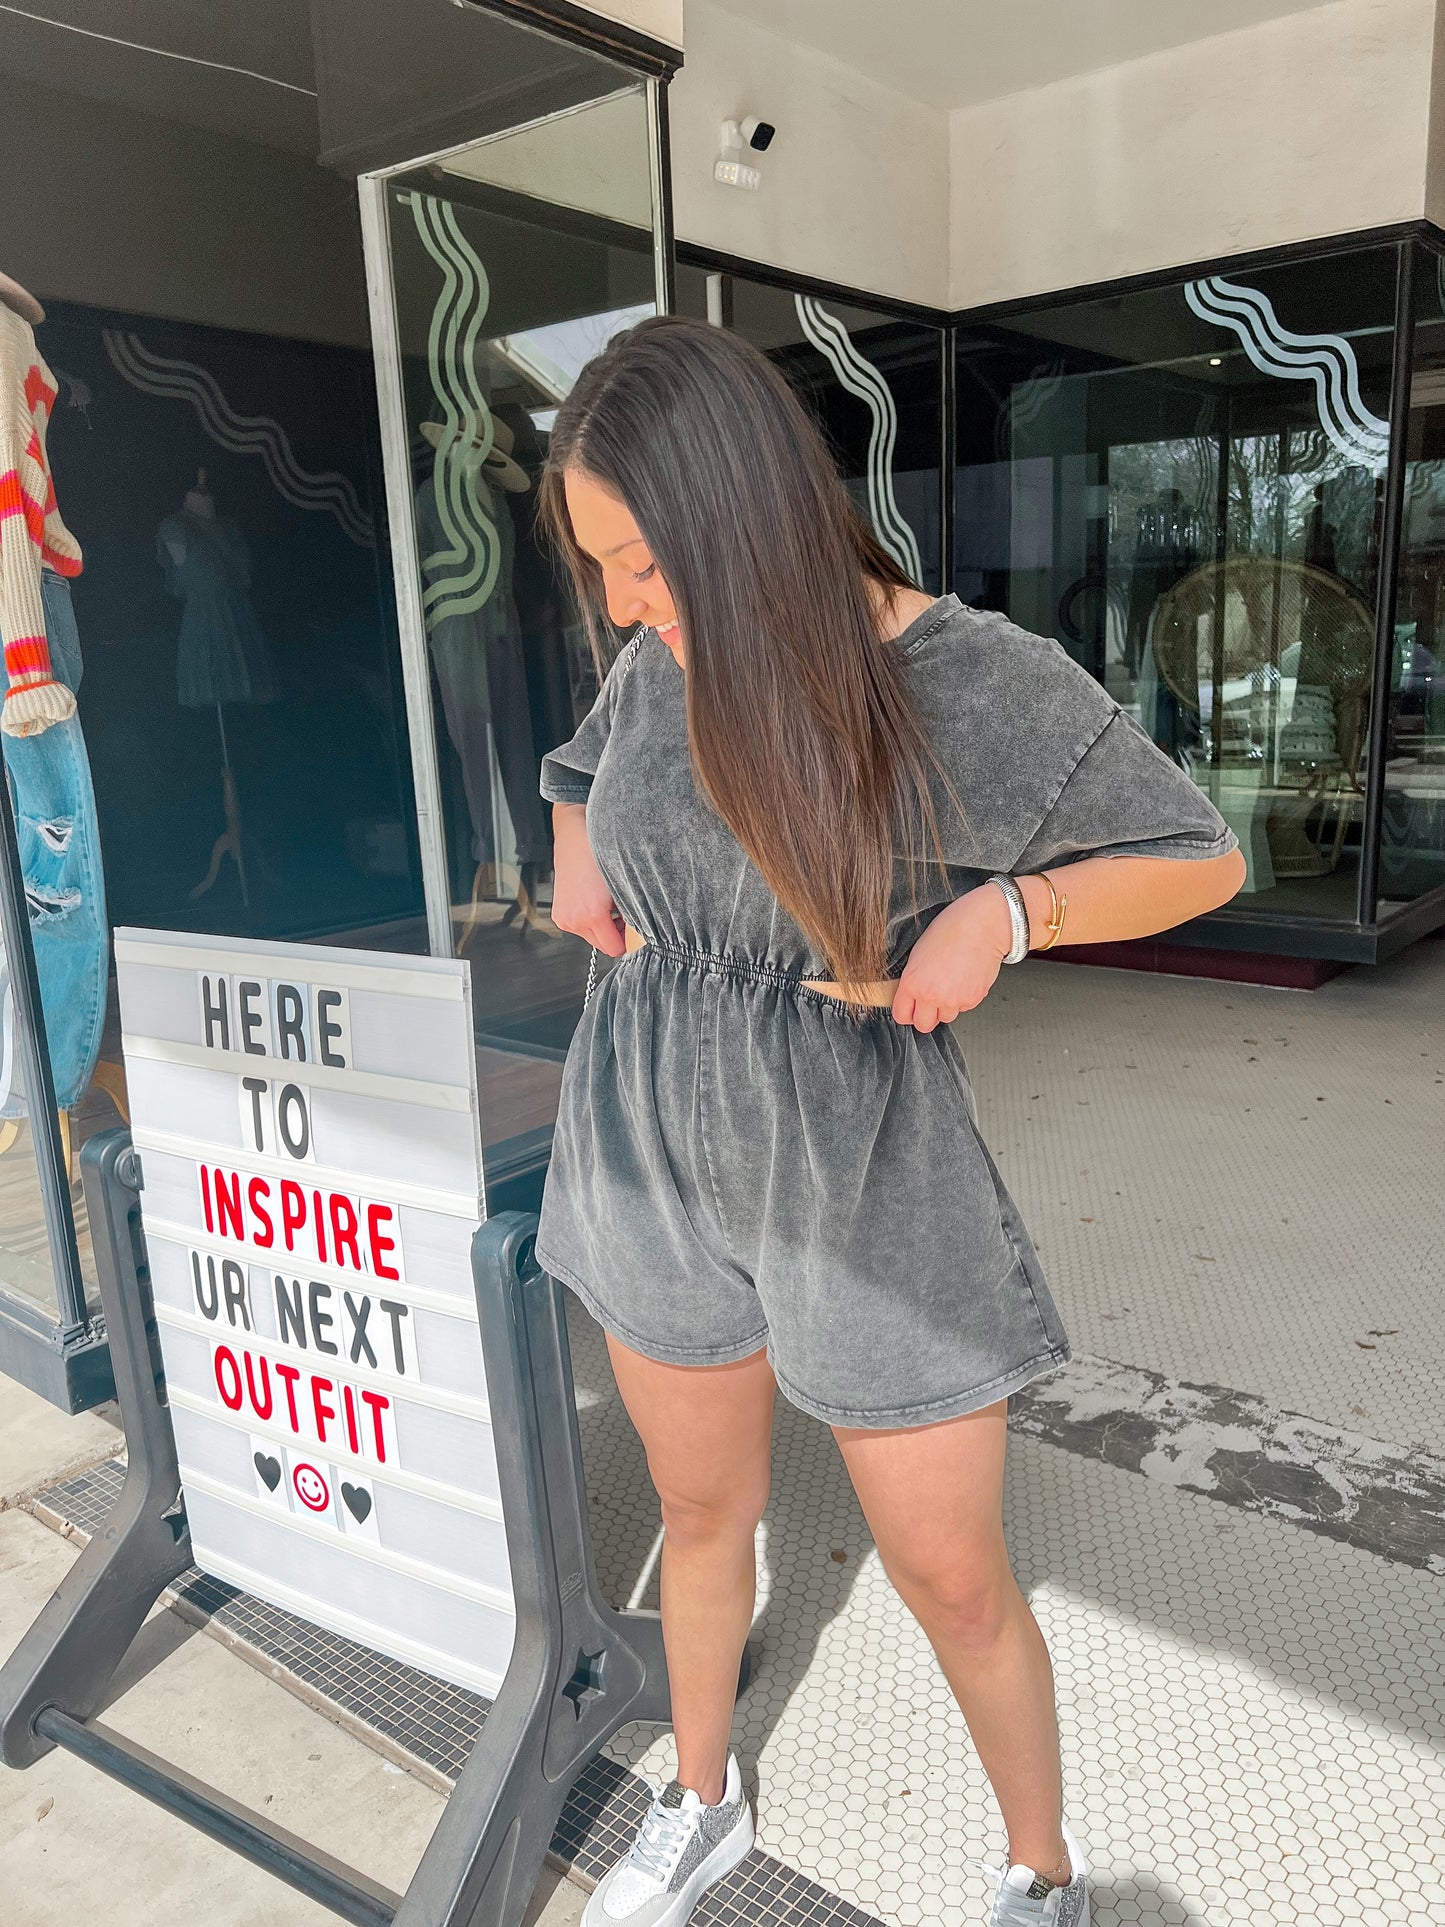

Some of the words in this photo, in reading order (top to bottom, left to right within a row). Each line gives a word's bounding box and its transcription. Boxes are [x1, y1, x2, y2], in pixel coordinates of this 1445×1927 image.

[202, 975, 346, 1069] HERE
[242, 1076, 309, 1160] TO
[199, 1164, 400, 1281] INSPIRE
[192, 1250, 252, 1331] UR
[274, 1275, 408, 1375] NEXT
[213, 1344, 390, 1464] OUTFIT
